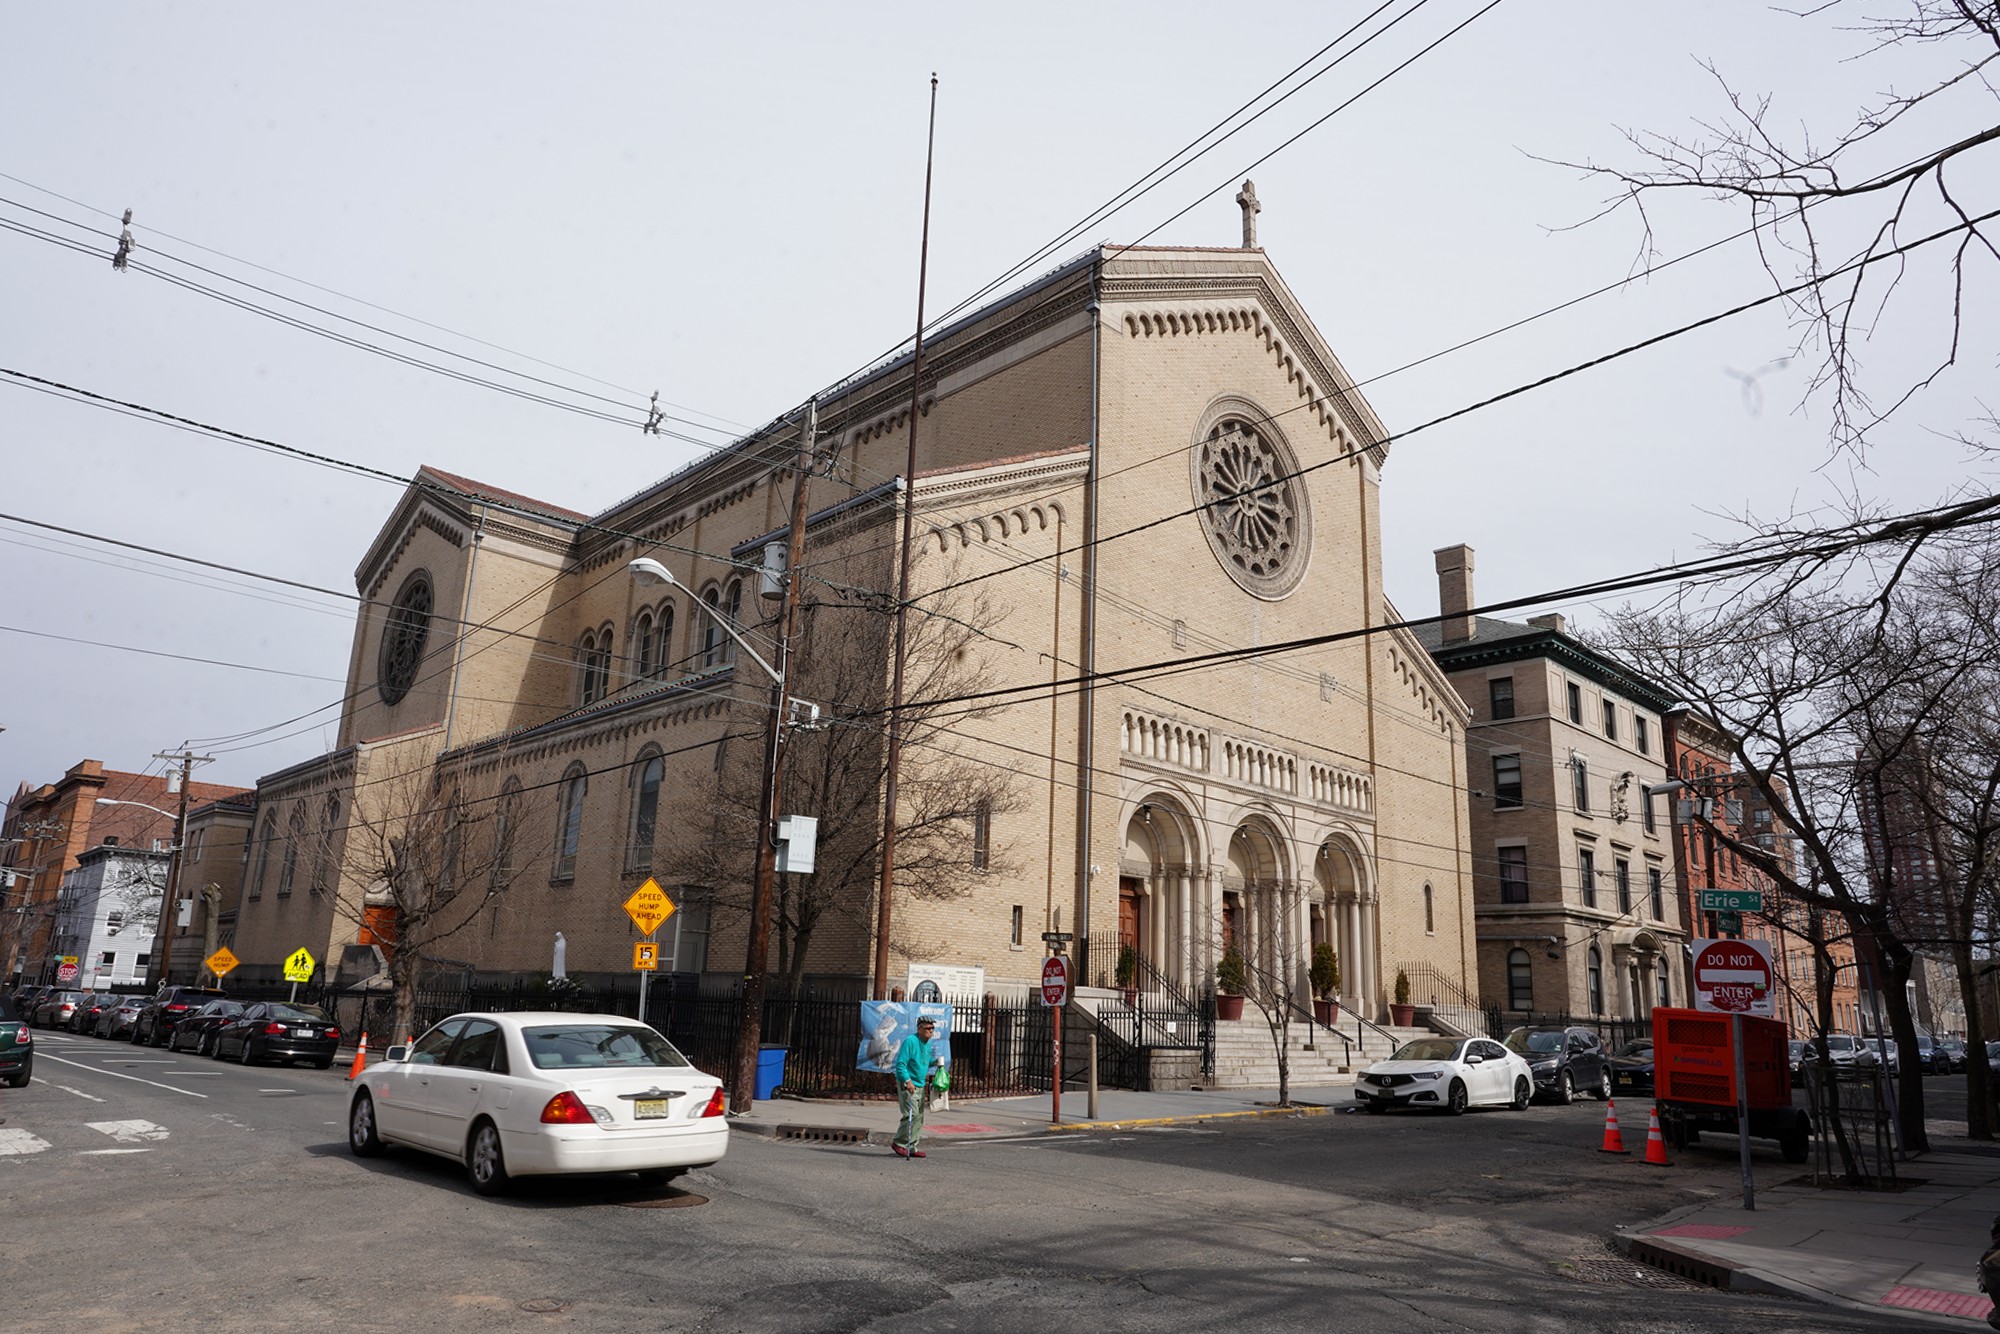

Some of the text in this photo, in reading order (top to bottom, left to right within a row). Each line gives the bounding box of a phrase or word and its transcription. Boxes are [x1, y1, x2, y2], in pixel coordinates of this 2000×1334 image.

[638, 893, 662, 901] SPEED
[1704, 893, 1758, 908] Erie St
[639, 947, 653, 959] 15
[1707, 954, 1754, 967] DO NOT
[59, 967, 78, 976] STOP
[1053, 966, 1062, 975] NOT
[288, 972, 308, 980] AHEAD
[1046, 987, 1061, 996] ENTER
[1713, 986, 1754, 999] ENTER
